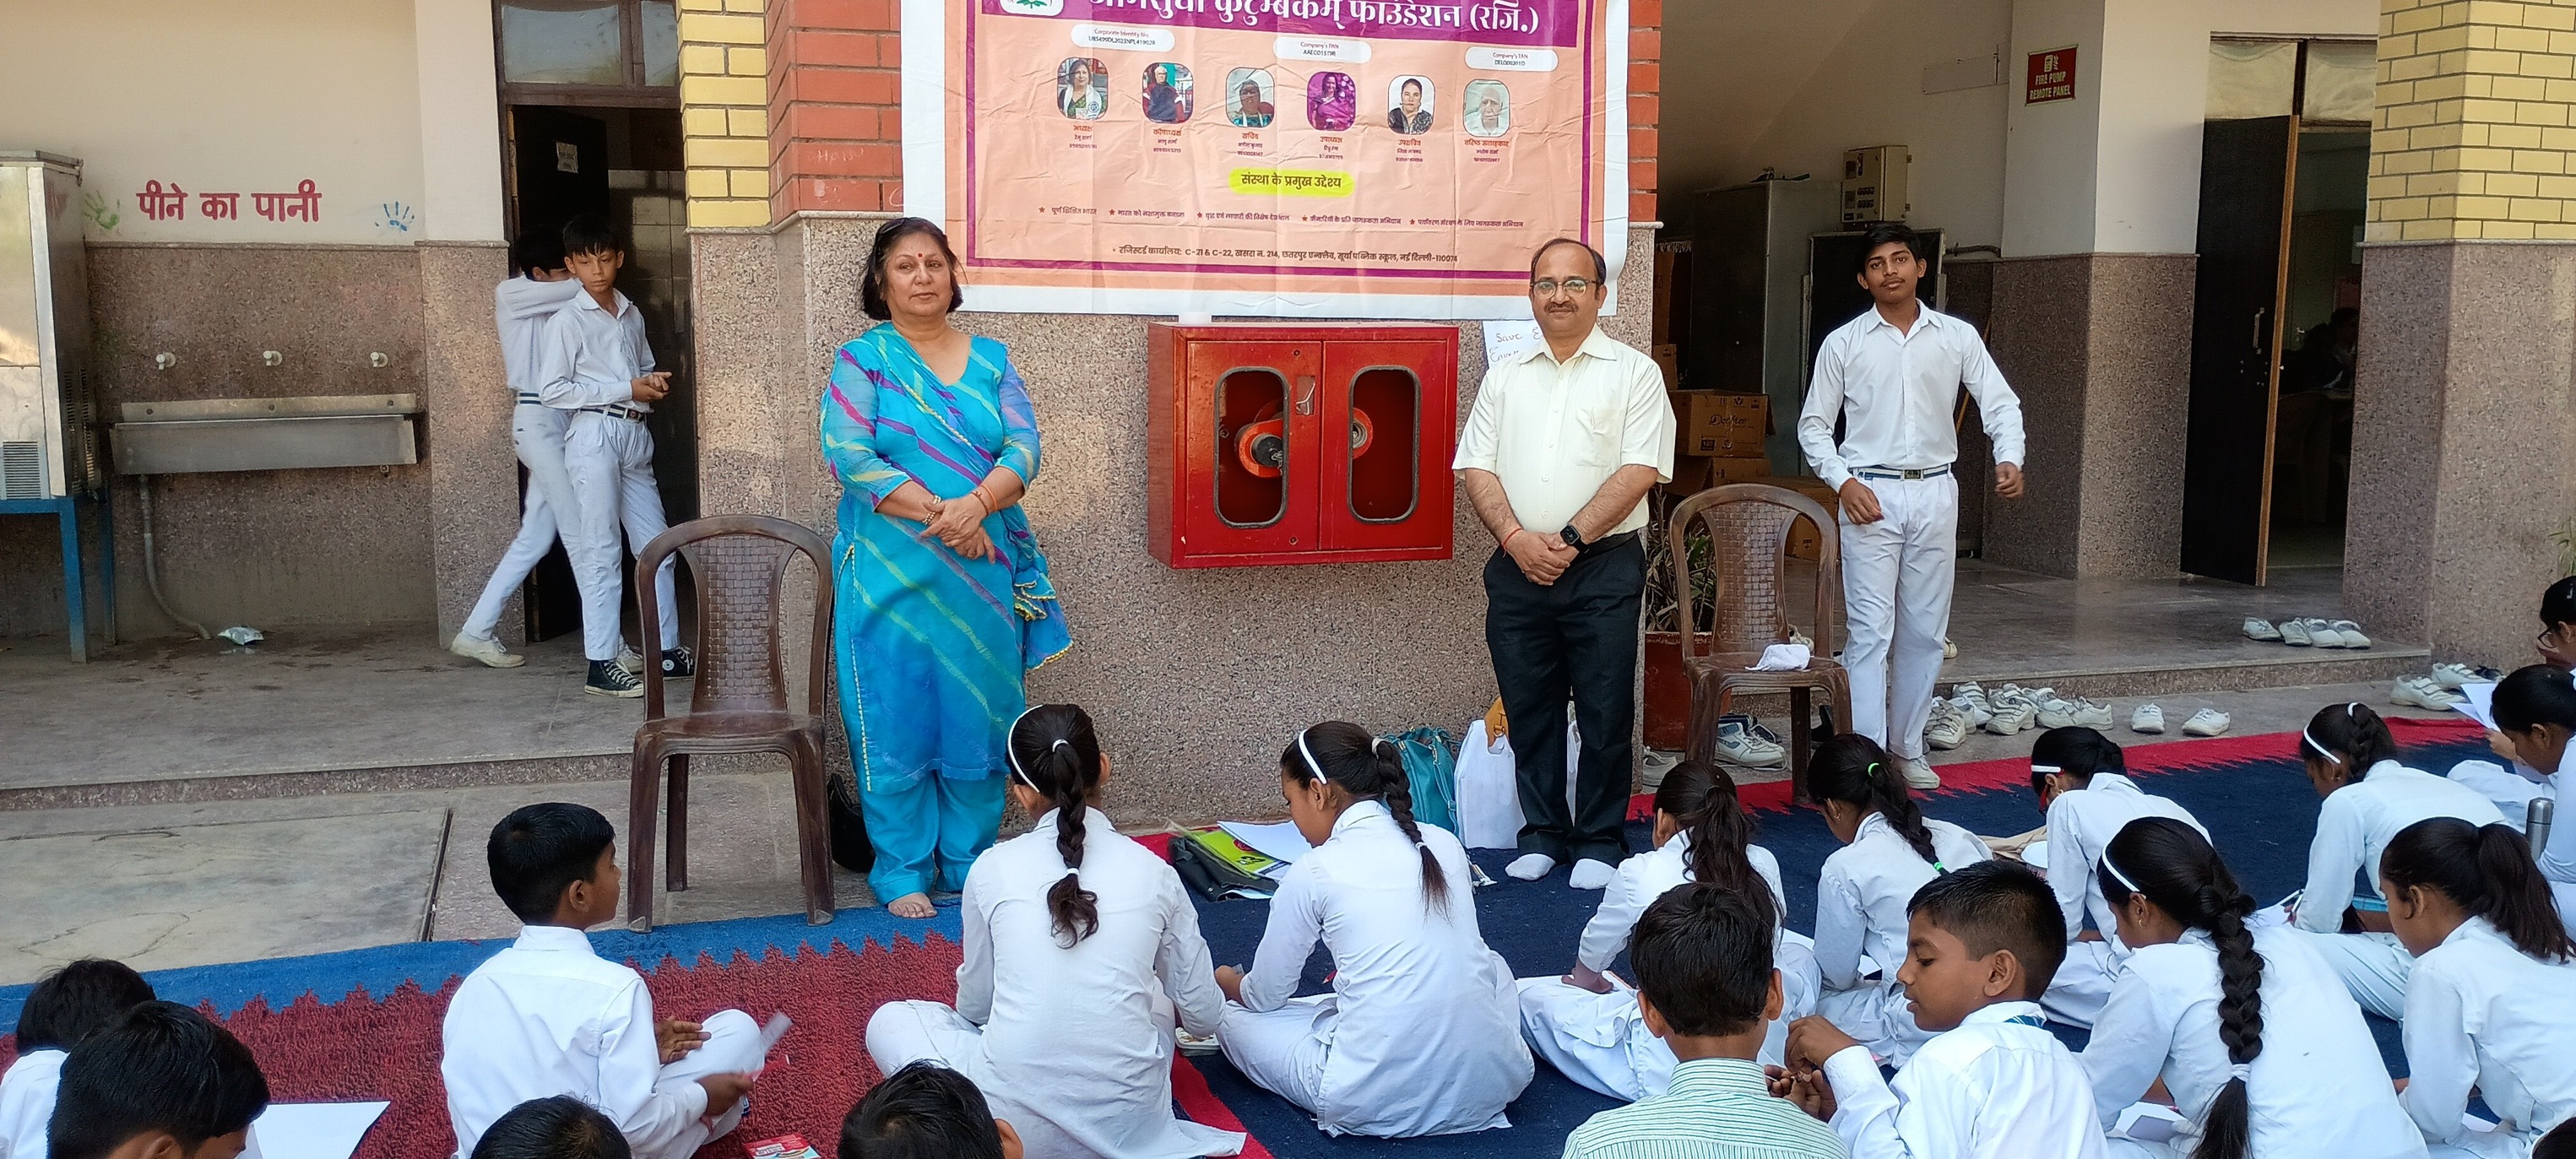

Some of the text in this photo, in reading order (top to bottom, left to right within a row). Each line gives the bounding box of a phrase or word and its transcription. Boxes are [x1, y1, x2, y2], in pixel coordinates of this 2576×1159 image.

[1350, 0, 1463, 28] फाउडशन
[1469, 0, 1540, 35] (रजि.)
[2035, 71, 2067, 85] FIRE PUMP
[2029, 84, 2071, 100] REMOTE PANEL
[1240, 171, 1342, 191] संस्था के प्रमुख उद्देश्य
[135, 179, 323, 223] पीने का पानी
[1119, 244, 1148, 255] रजिस्टर्ड
[1185, 248, 1203, 257] C-21
[1212, 249, 1234, 258] C-22,
[1234, 249, 1255, 257] खसरा
[1281, 251, 1307, 261] छतरपुर
[1353, 252, 1377, 261] पब्लिक
[1378, 253, 1398, 263] स्कूल,
[1399, 252, 1411, 262] नई
[1495, 333, 1523, 343] Save
